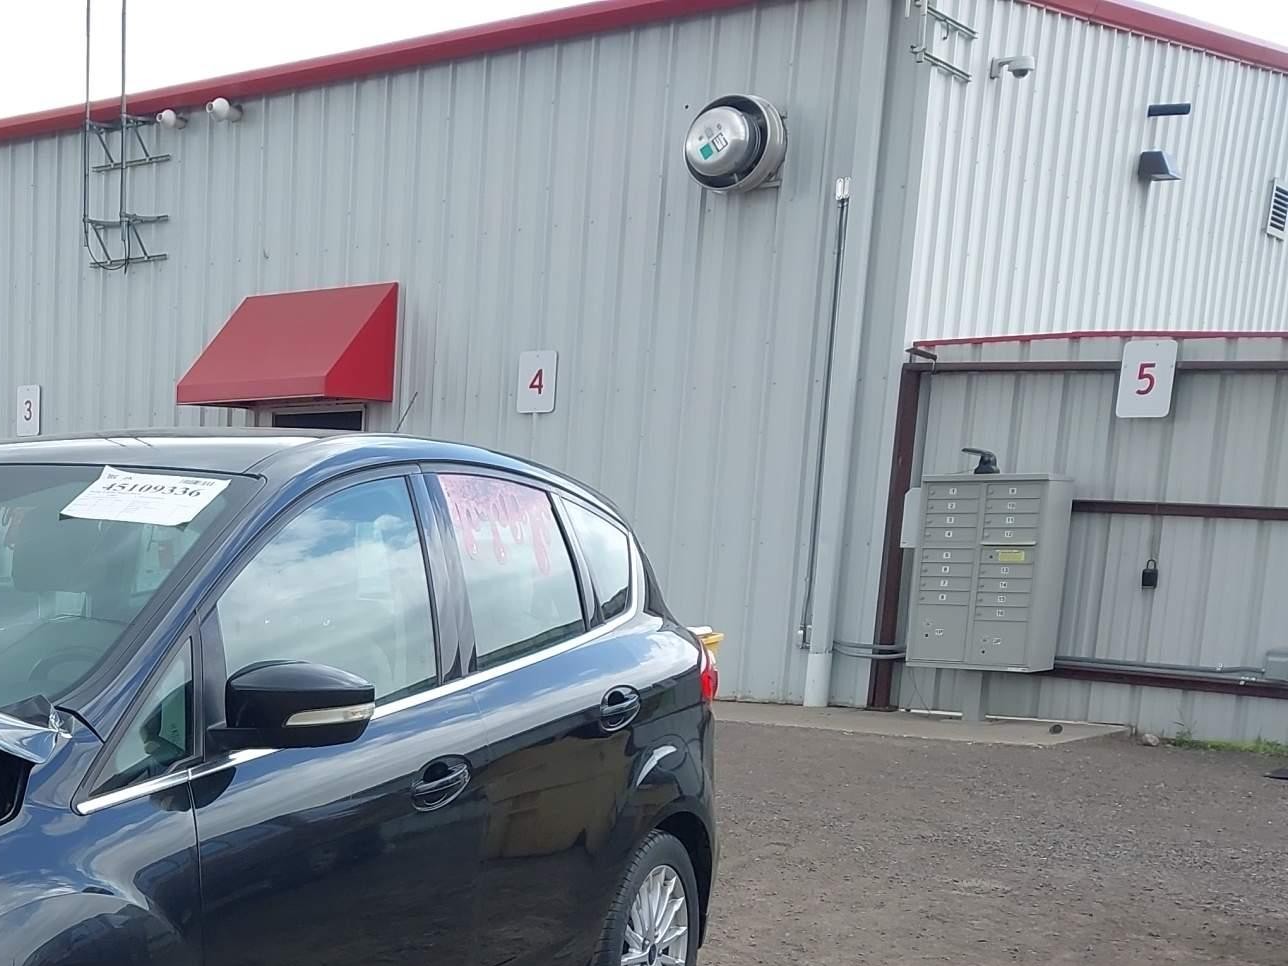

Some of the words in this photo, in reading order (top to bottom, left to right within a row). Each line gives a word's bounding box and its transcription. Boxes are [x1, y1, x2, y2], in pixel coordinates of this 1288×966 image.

[528, 368, 544, 395] 4
[1135, 362, 1157, 396] 5
[23, 399, 33, 422] 3
[101, 482, 204, 498] 45109336
